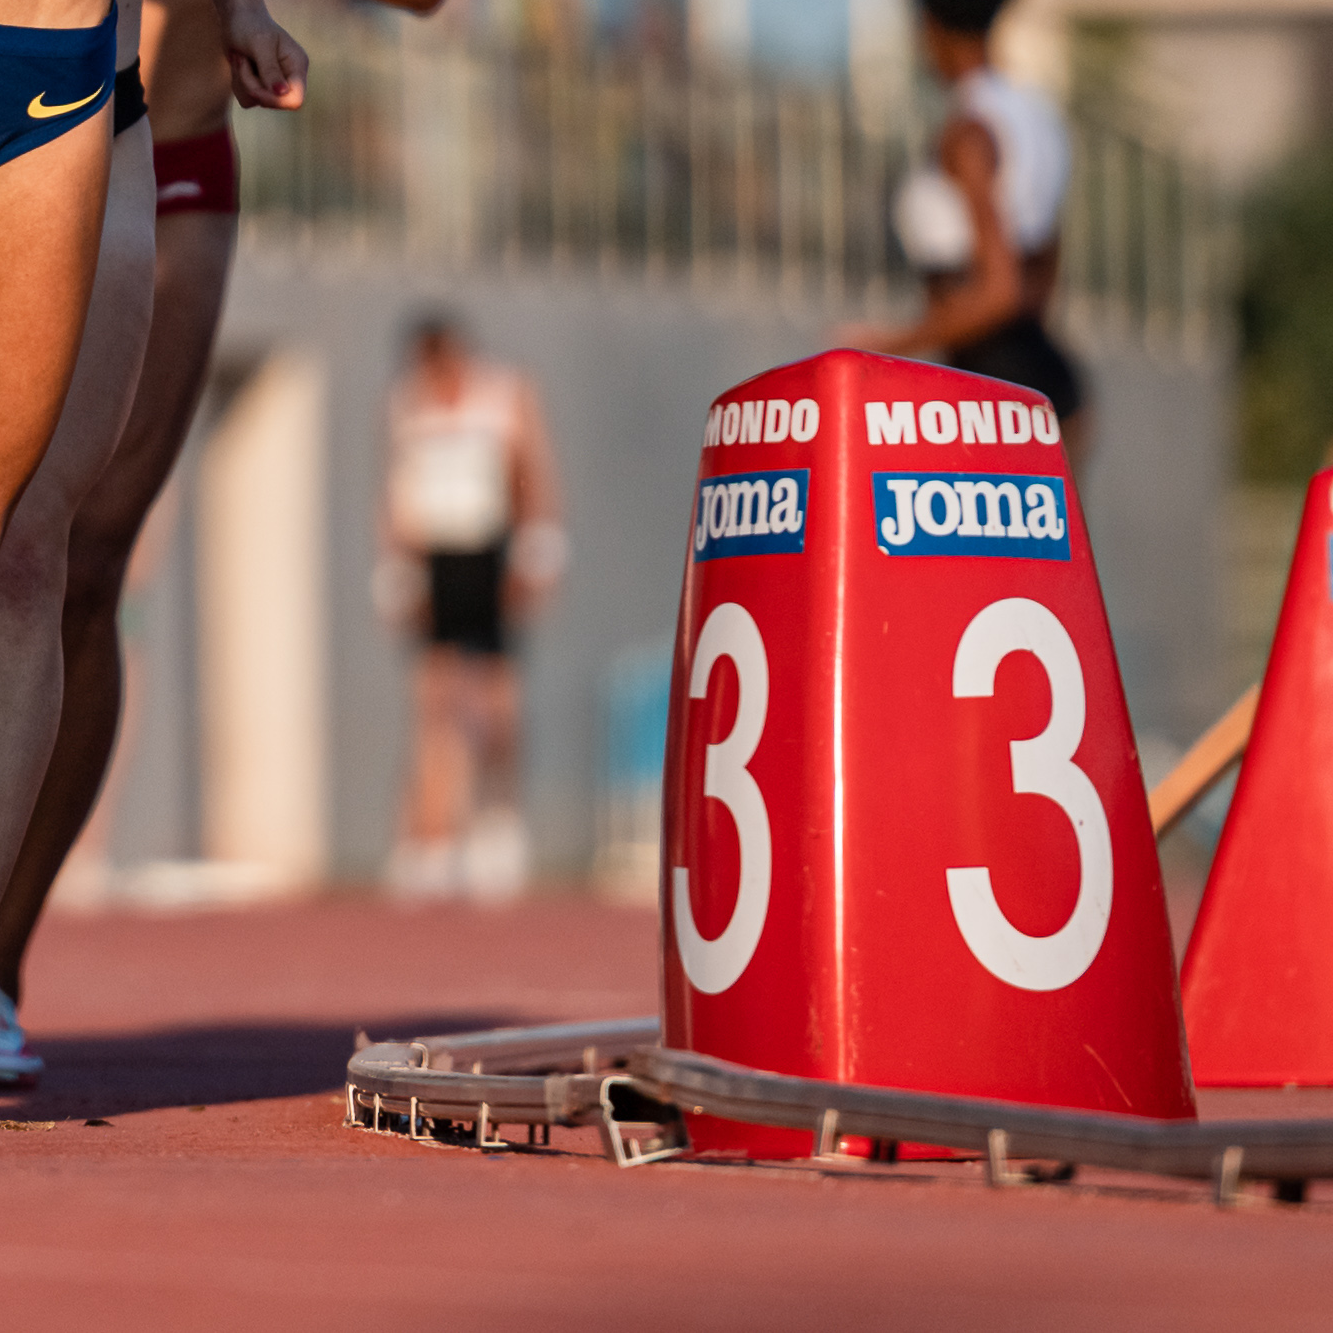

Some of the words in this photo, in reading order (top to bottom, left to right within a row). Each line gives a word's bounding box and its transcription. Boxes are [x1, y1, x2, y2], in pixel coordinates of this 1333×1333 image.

[704, 399, 820, 447] MONDO
[865, 400, 1060, 445] MONDO
[673, 602, 772, 994] 3
[946, 597, 1114, 992] 3
